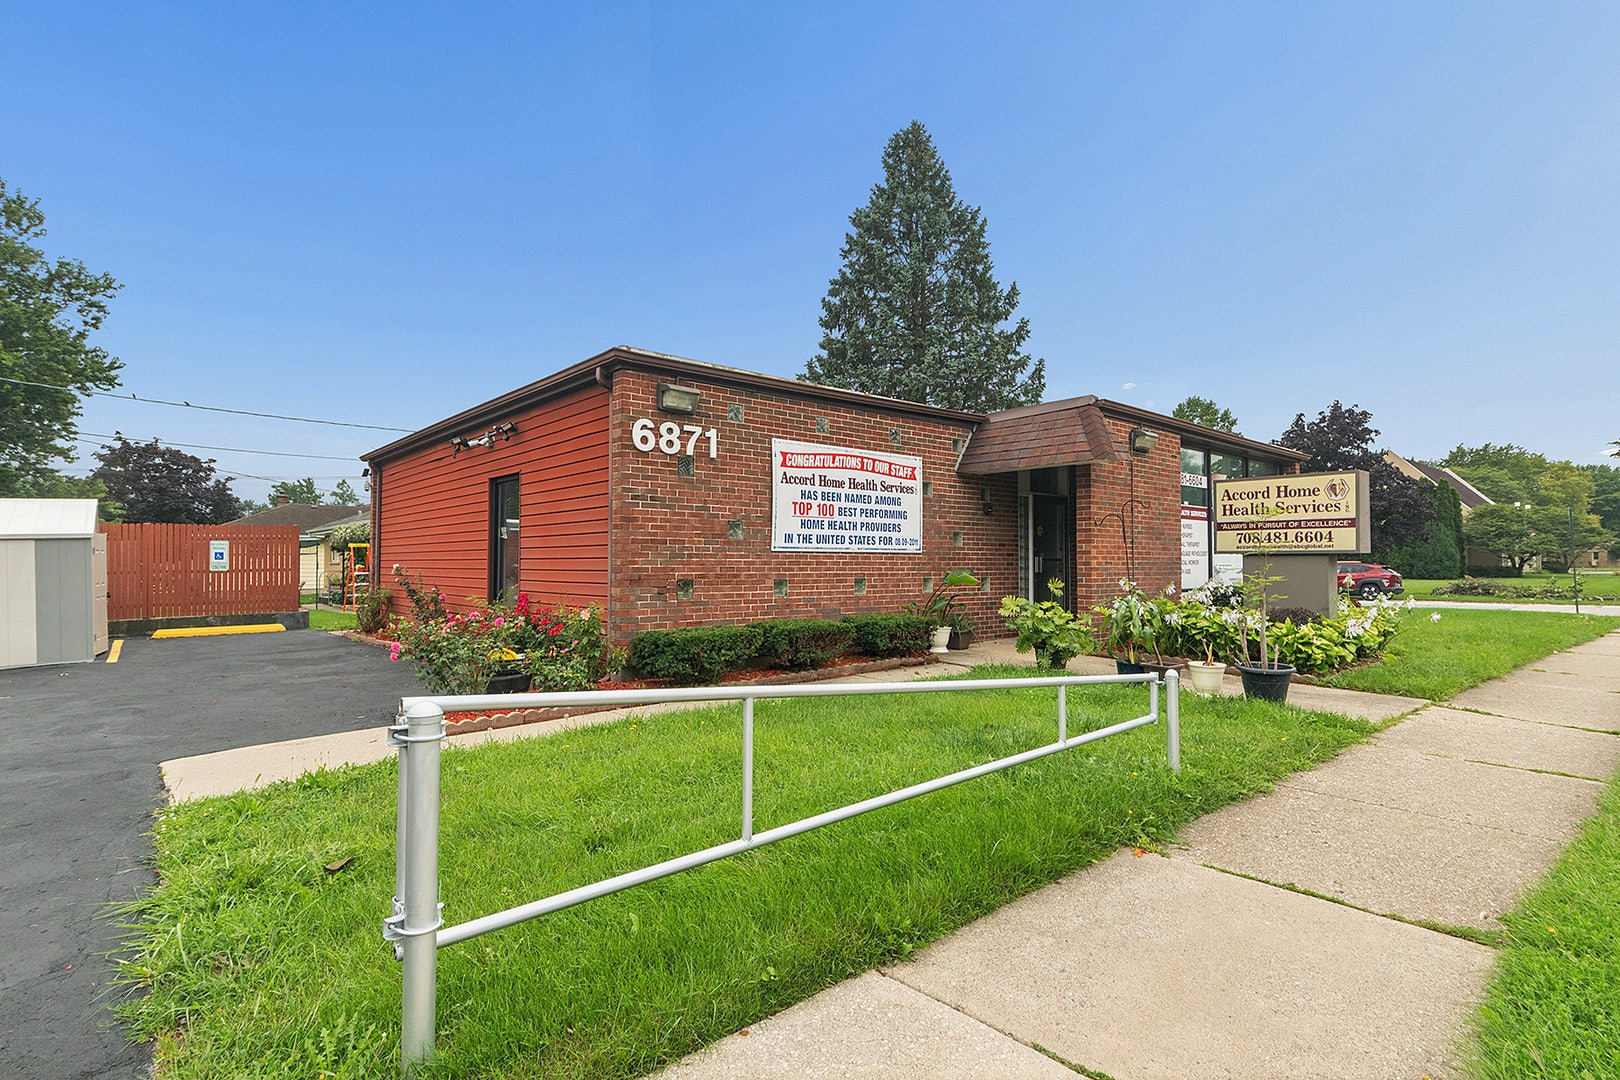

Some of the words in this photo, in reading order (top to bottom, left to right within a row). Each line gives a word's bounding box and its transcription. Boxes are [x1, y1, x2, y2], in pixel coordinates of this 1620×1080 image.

[632, 418, 717, 458] 6871
[786, 453, 861, 469] CONGRATULATIONS
[863, 458, 873, 471] TO
[874, 460, 890, 474] OUR
[891, 464, 912, 478] STAFF
[780, 471, 815, 486] Accord
[818, 474, 845, 489] Home
[848, 477, 878, 491] Health
[880, 480, 914, 494] Services
[801, 490, 818, 500] HAS
[821, 491, 841, 502] BEEN
[844, 493, 872, 504] NAMED
[874, 495, 901, 507] AMONG
[1221, 486, 1270, 501] Accord
[1276, 485, 1320, 498] Home
[792, 501, 813, 516] TOP
[817, 503, 835, 517] 100
[838, 506, 857, 518] BEST
[860, 508, 908, 520] PERFORMING
[1222, 502, 1270, 517] Health
[1275, 500, 1341, 514] Services
[800, 519, 825, 530] HOME
[828, 520, 857, 531] HEALTH
[860, 522, 902, 533] PROVIDERS
[1258, 522, 1287, 530] PURSUIT
[784, 533, 793, 544] IN
[797, 534, 813, 544] THE
[816, 534, 846, 545] UNITED
[848, 535, 876, 546] STATES
[879, 536, 893, 546] FOR
[1236, 530, 1334, 544] 708.481.6604
